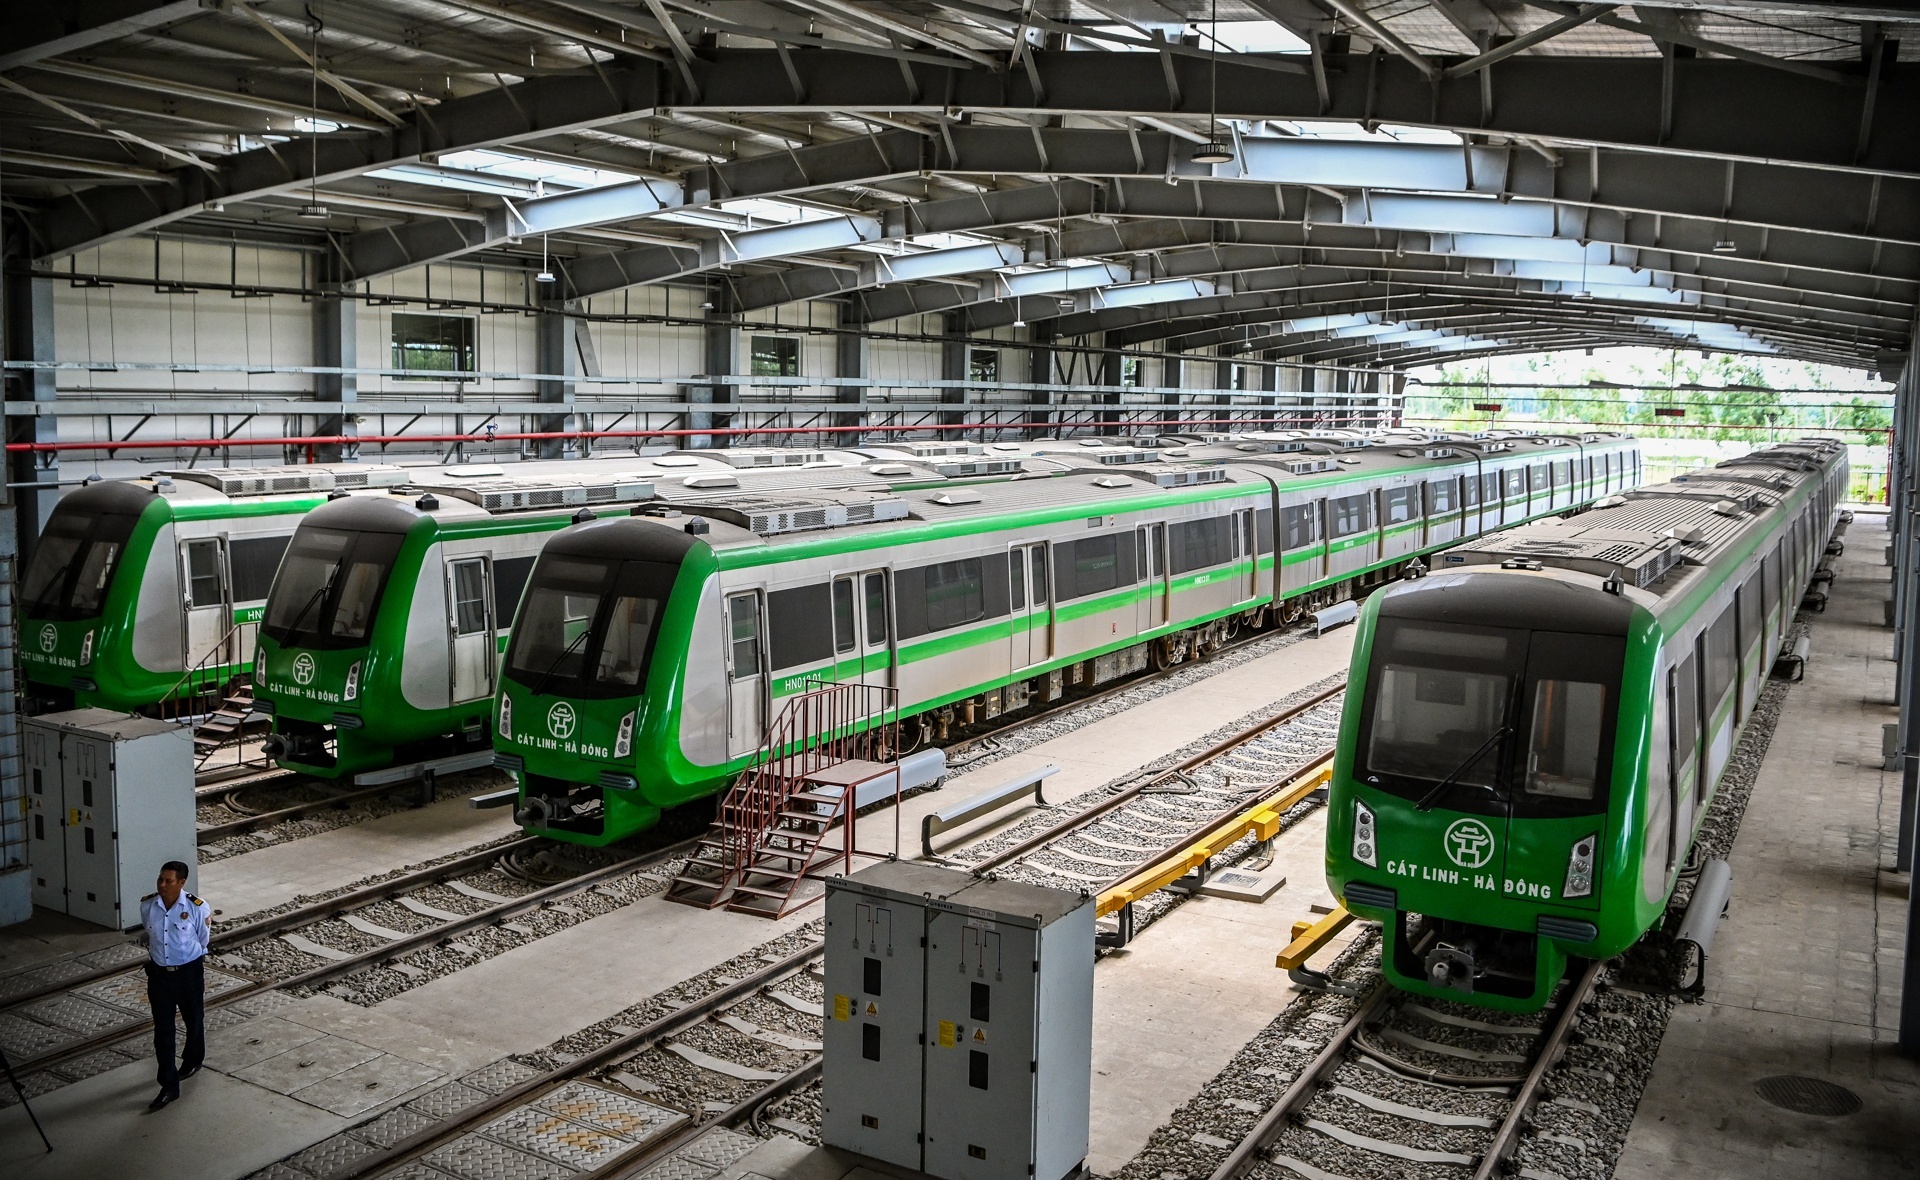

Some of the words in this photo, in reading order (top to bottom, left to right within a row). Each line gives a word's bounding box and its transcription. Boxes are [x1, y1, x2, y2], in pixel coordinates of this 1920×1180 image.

[32, 653, 45, 662] LINH
[270, 682, 283, 693] CÁT
[284, 685, 301, 697] LINH
[306, 688, 316, 699] HÀ
[517, 733, 534, 746] CÁT
[536, 737, 557, 750] LINH
[565, 741, 577, 753] HÀ
[581, 743, 608, 758] ĐÔNG
[1386, 860, 1418, 877] CÁT
[1423, 866, 1459, 884] LINH
[1474, 874, 1495, 891] HÀ
[1504, 878, 1551, 899] ĐÔNG
